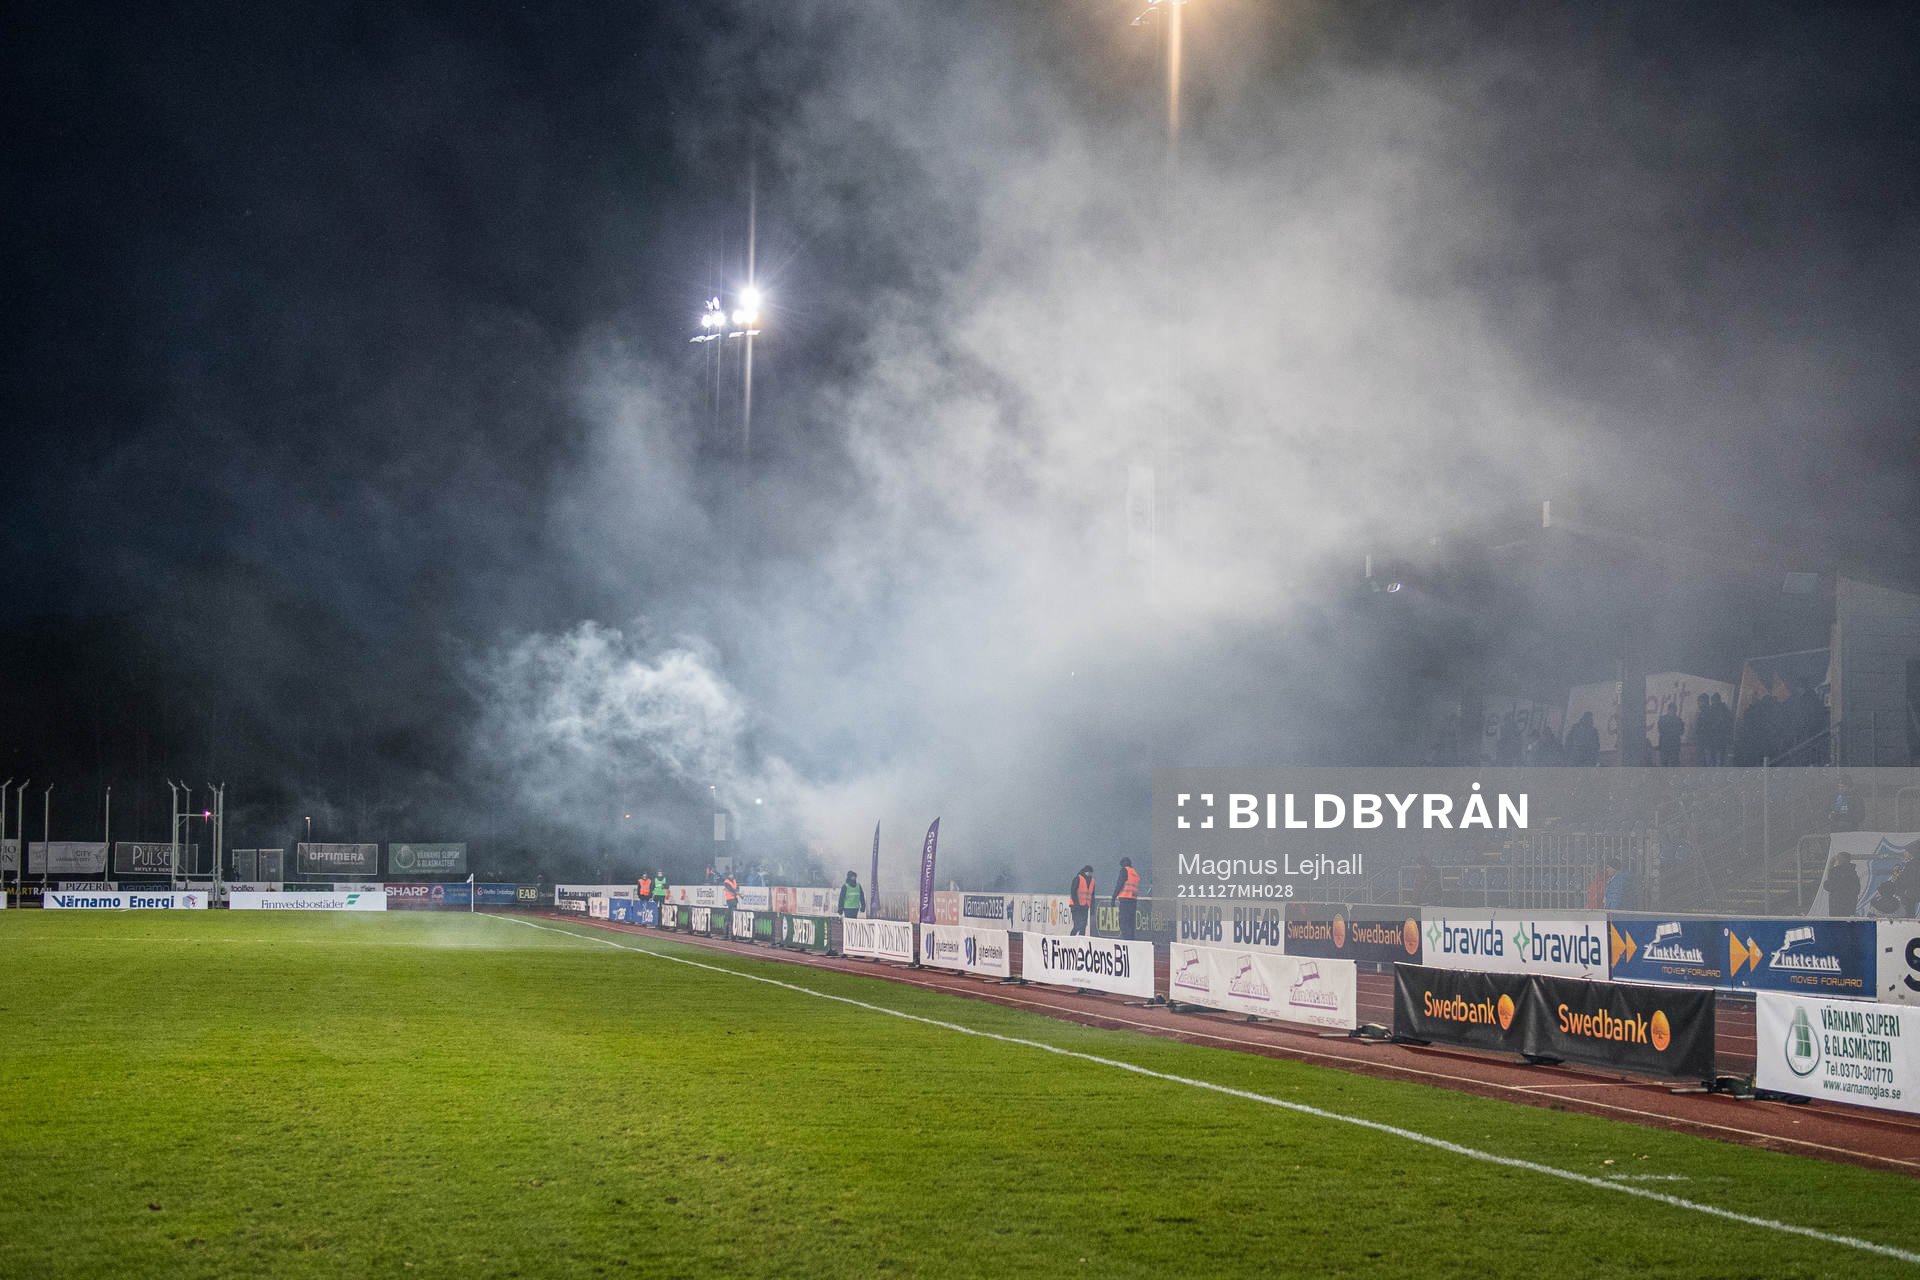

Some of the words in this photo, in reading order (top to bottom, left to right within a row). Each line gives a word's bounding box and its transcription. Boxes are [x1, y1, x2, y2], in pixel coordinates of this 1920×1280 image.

[310, 852, 366, 861] OPTIMERA
[66, 883, 113, 891] PIZZERIA
[385, 887, 429, 896] SHARP
[518, 889, 537, 899] EAB
[52, 895, 121, 908] Värnamo
[129, 895, 175, 909] Energi
[261, 899, 345, 909] Finnvedsbostäder
[1181, 904, 1223, 942] BUFAB
[1233, 906, 1280, 947] BUFAB
[1287, 920, 1332, 940] Swedbank
[1352, 922, 1403, 946] Swedbank
[1443, 918, 1504, 956] bravida
[1531, 922, 1601, 965] bravida
[1114, 944, 1130, 978] Bil
[1790, 975, 1818, 985] MOVES
[1820, 977, 1863, 988] FORWARD
[1424, 990, 1497, 1025] Swedbank
[1821, 1005, 1864, 1034] VÄRNAMO
[1558, 1003, 1648, 1044] Swedbank
[1824, 1034, 1831, 1055] &
[1832, 1034, 1892, 1063] GLASMÄSTERI
[1823, 1079, 1901, 1100] www.varnamoglas.se
